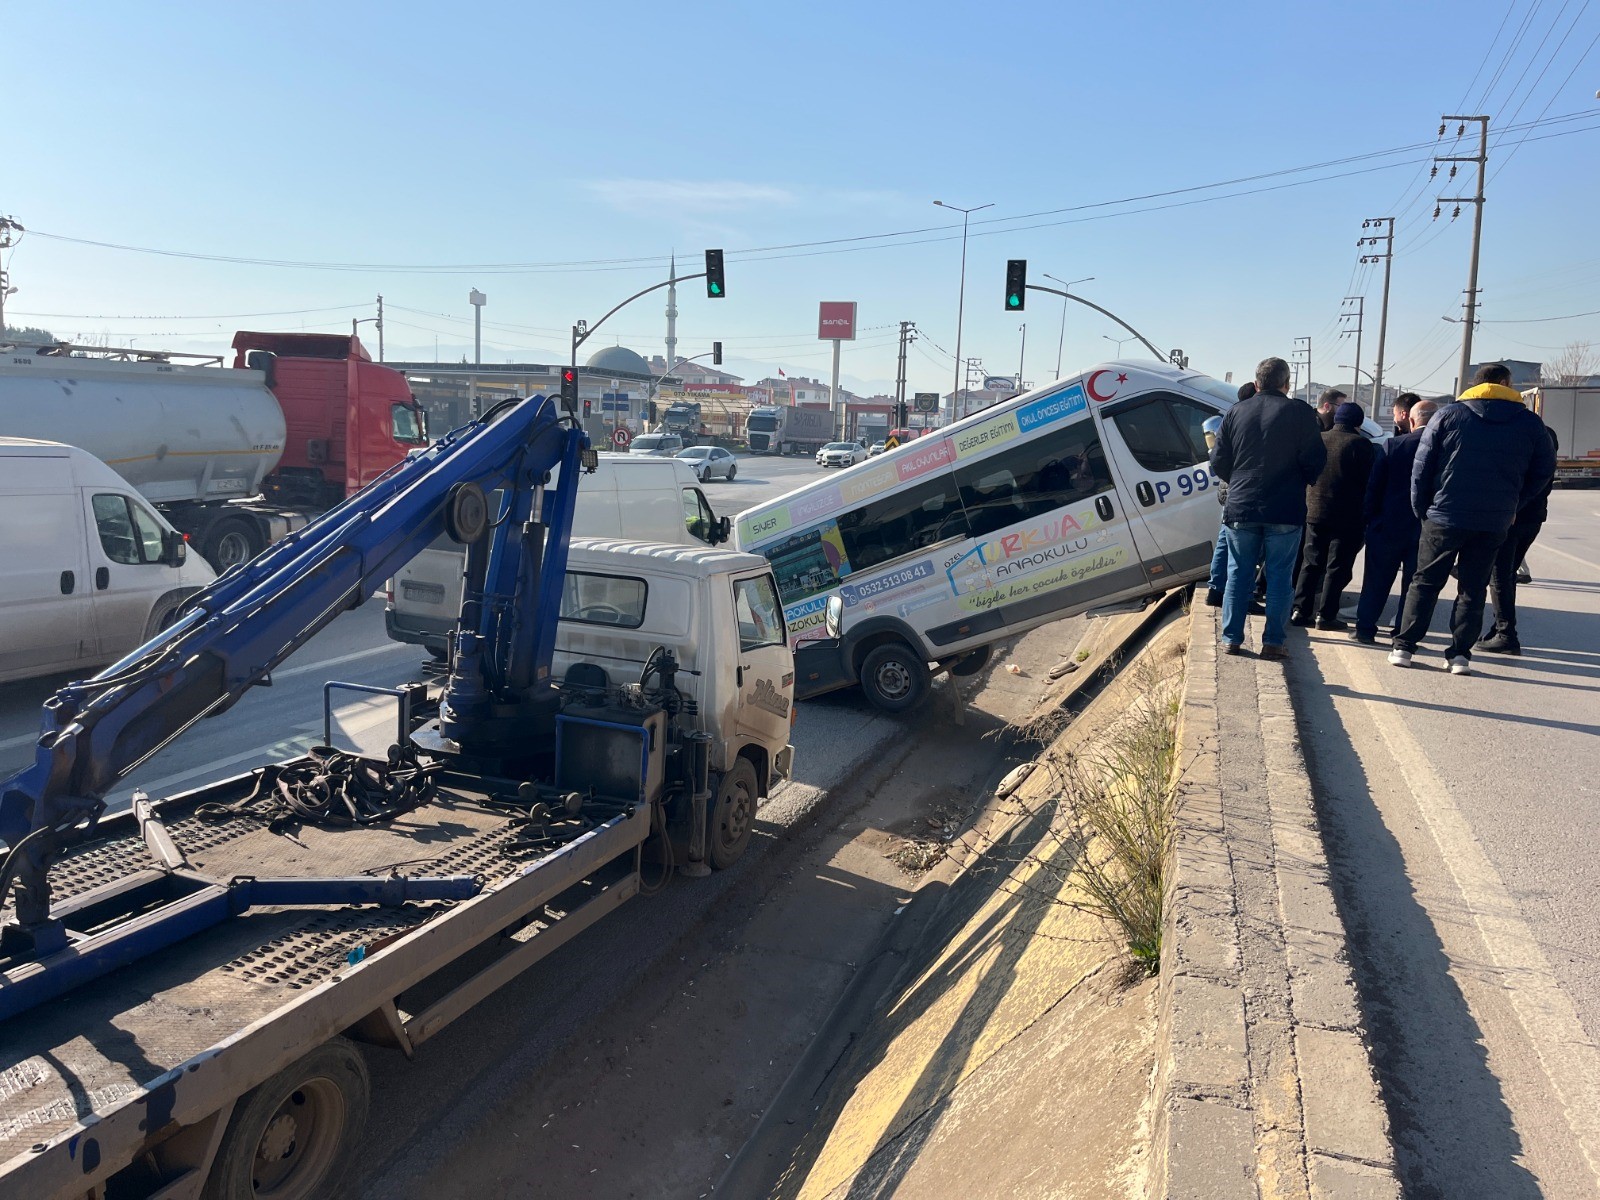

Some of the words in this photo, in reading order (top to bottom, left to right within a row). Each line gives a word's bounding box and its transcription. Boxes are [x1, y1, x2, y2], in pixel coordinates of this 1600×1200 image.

[1021, 414, 1038, 427] OKUL
[1155, 481, 1171, 503] P
[944, 552, 964, 568] ÖZEL
[972, 510, 1100, 566] TURKUAZ
[996, 537, 1088, 578] ANAOKULU
[859, 580, 884, 597] 0532
[884, 575, 901, 588] 513
[901, 571, 914, 582] 08
[914, 565, 927, 577] 41
[1008, 584, 1030, 598] her
[1032, 569, 1069, 592] çocuk
